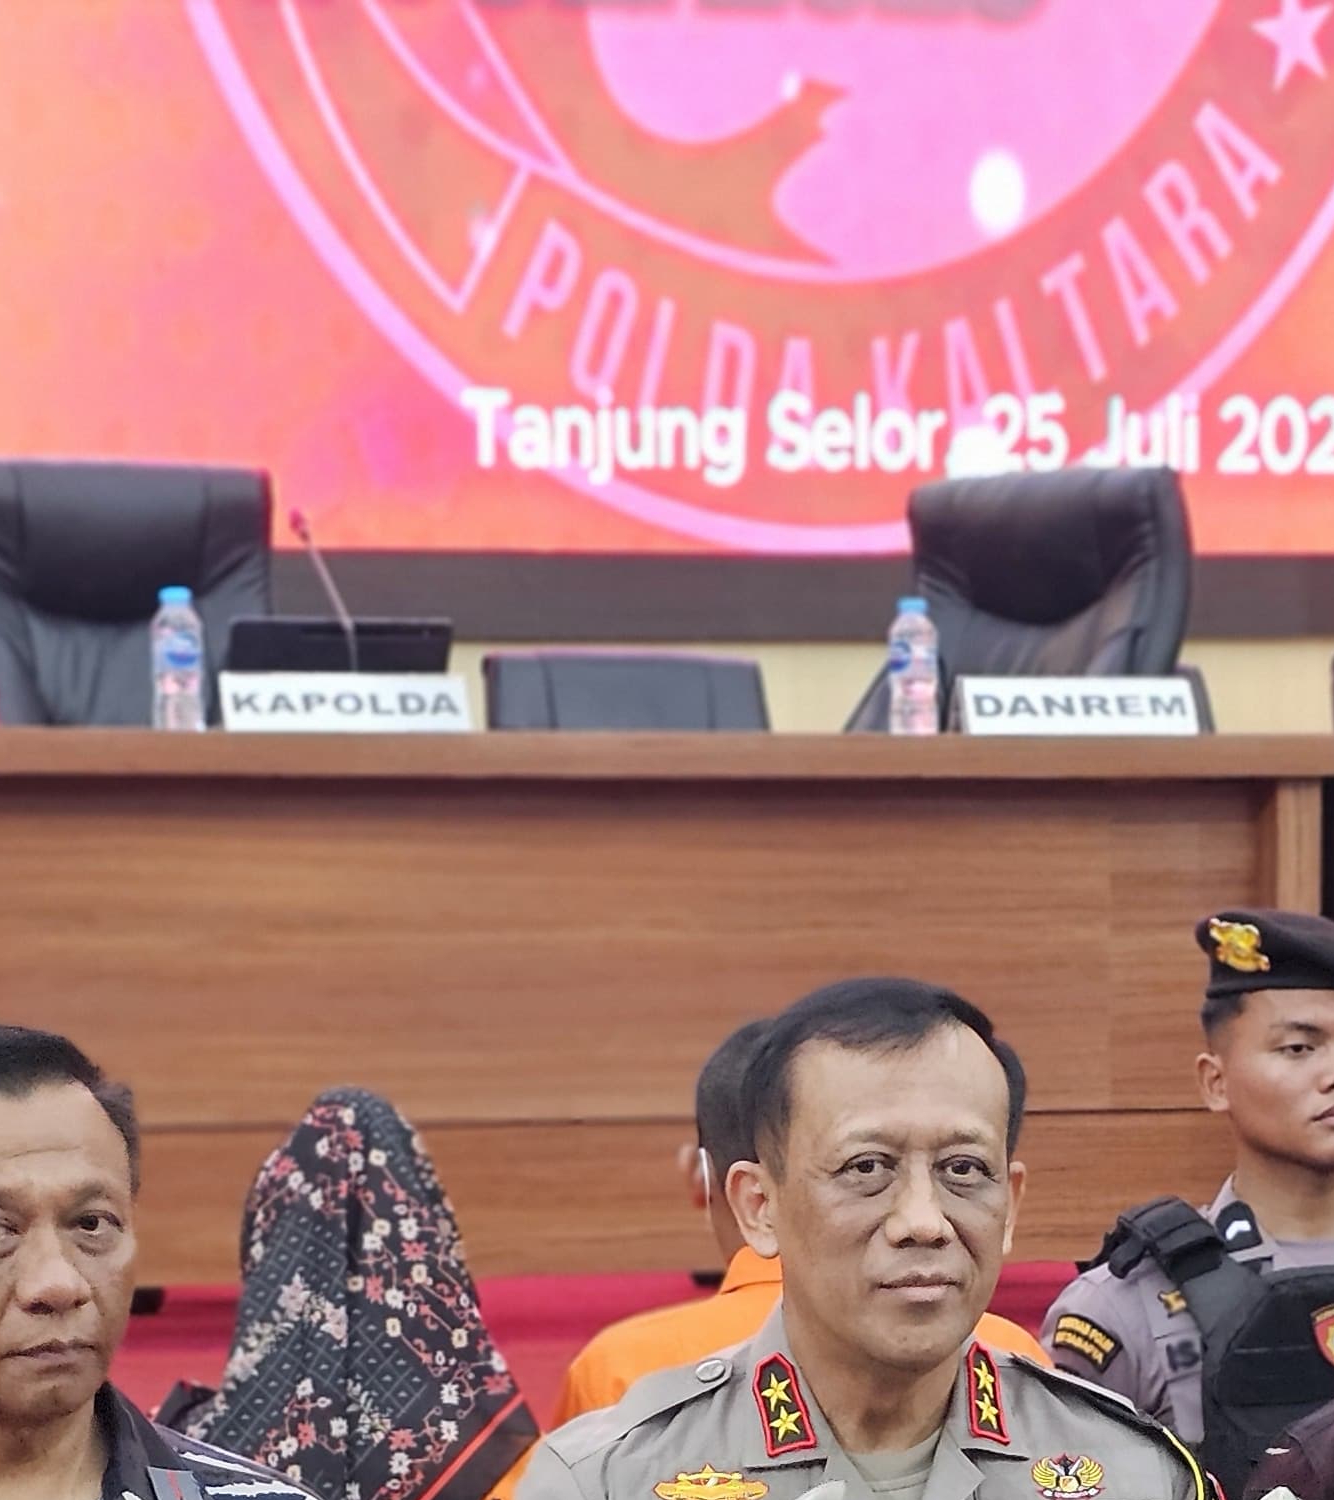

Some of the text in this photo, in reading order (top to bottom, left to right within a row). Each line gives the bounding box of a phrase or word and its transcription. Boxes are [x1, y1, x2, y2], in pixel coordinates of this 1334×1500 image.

[460, 386, 748, 488] Tanjung
[981, 394, 1069, 474] 25
[1084, 393, 1200, 474] Juli
[229, 687, 460, 719] KAPOLDA
[972, 691, 1188, 721] DANREM
